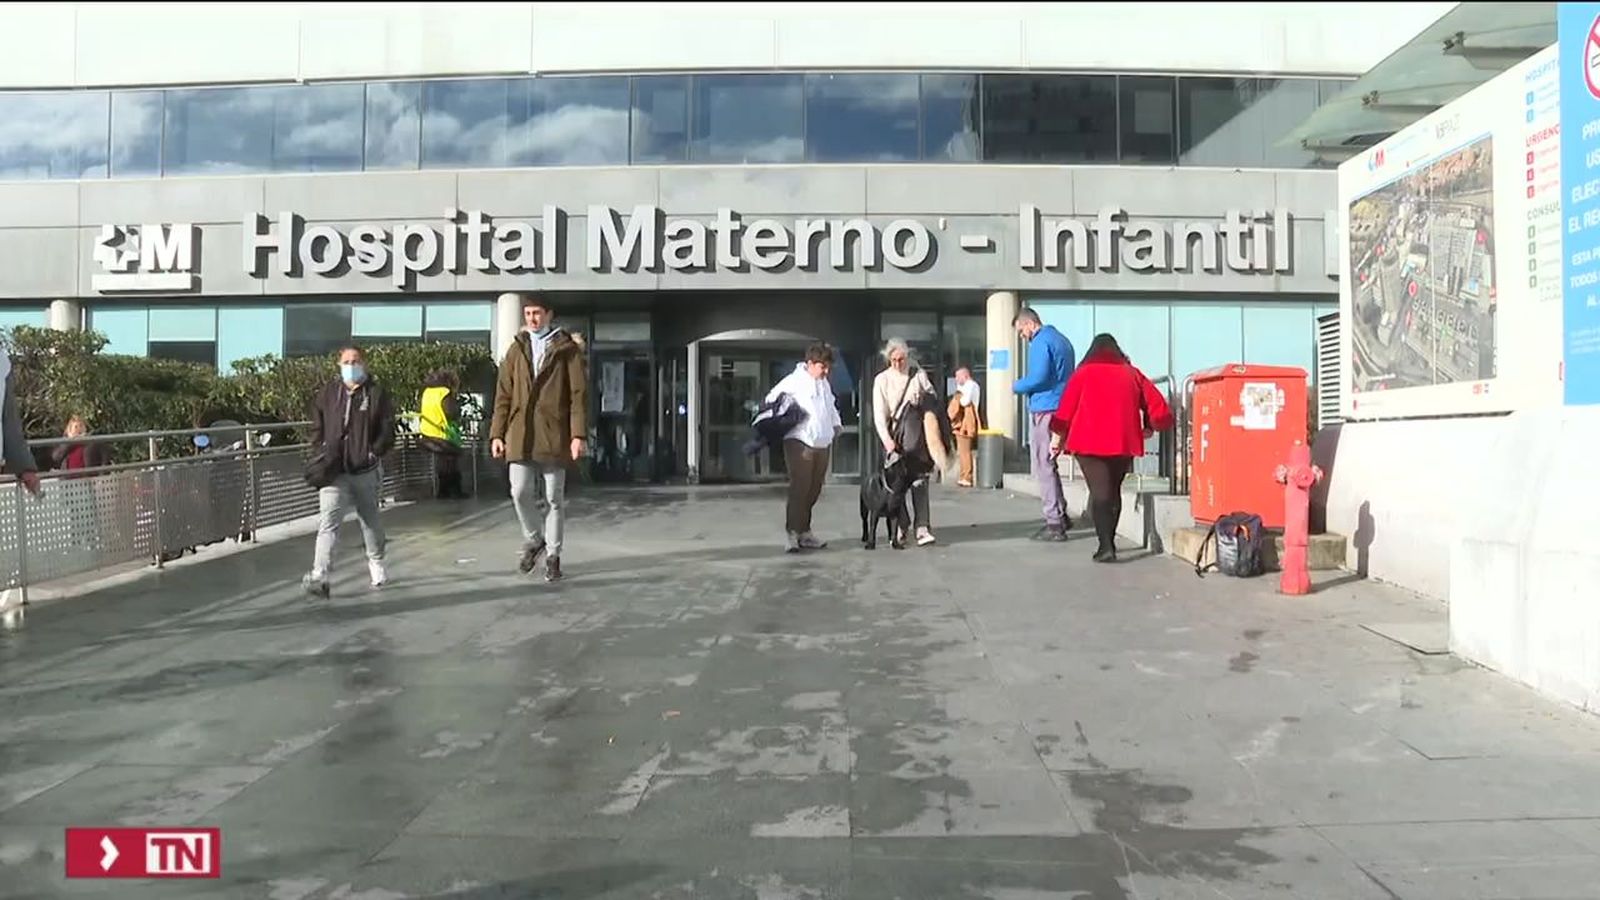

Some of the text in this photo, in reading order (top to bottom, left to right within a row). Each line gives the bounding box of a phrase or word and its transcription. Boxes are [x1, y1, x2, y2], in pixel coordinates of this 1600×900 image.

[242, 204, 558, 288] Hospital
[587, 204, 931, 269] Materno
[1019, 202, 1290, 272] Infantil
